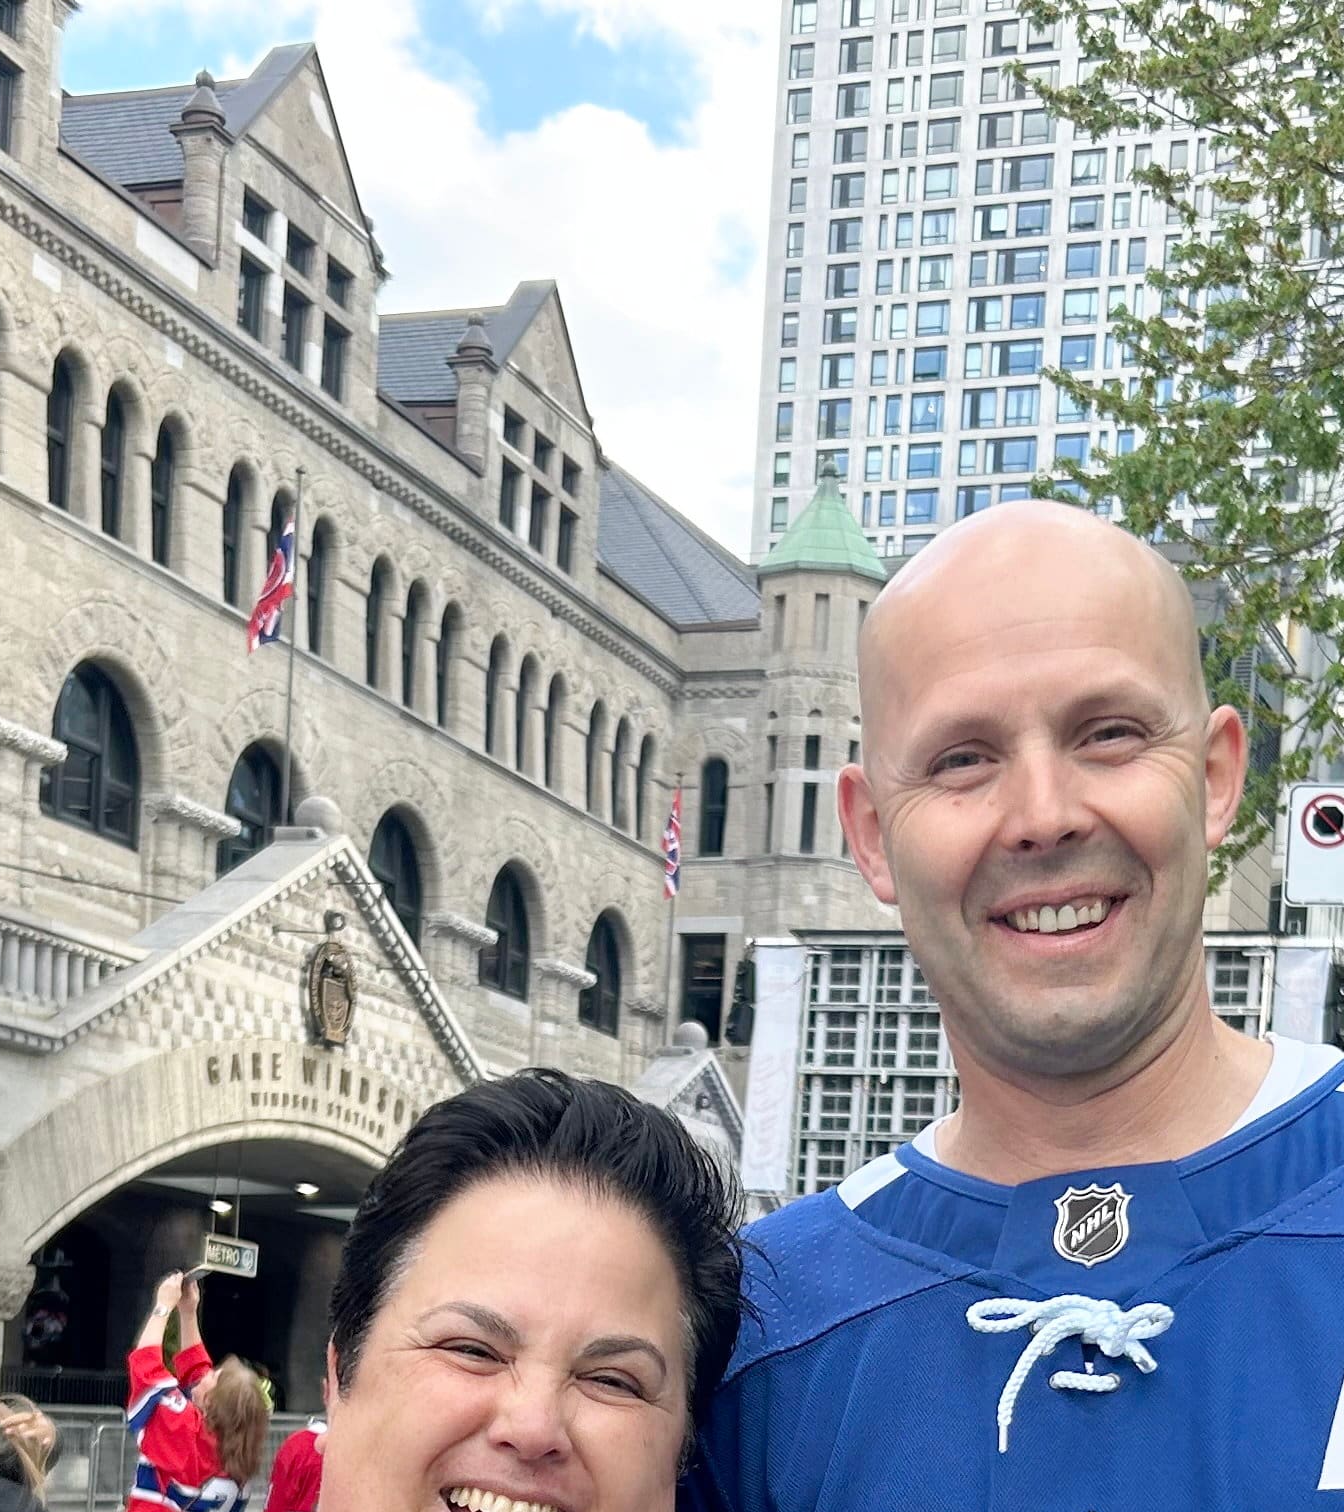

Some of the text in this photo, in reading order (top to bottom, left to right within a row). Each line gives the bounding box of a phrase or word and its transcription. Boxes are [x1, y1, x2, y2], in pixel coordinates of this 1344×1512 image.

[206, 1052, 283, 1086] GARE
[250, 1092, 385, 1139] WINDSOR STATION
[1069, 1204, 1114, 1250] NHL
